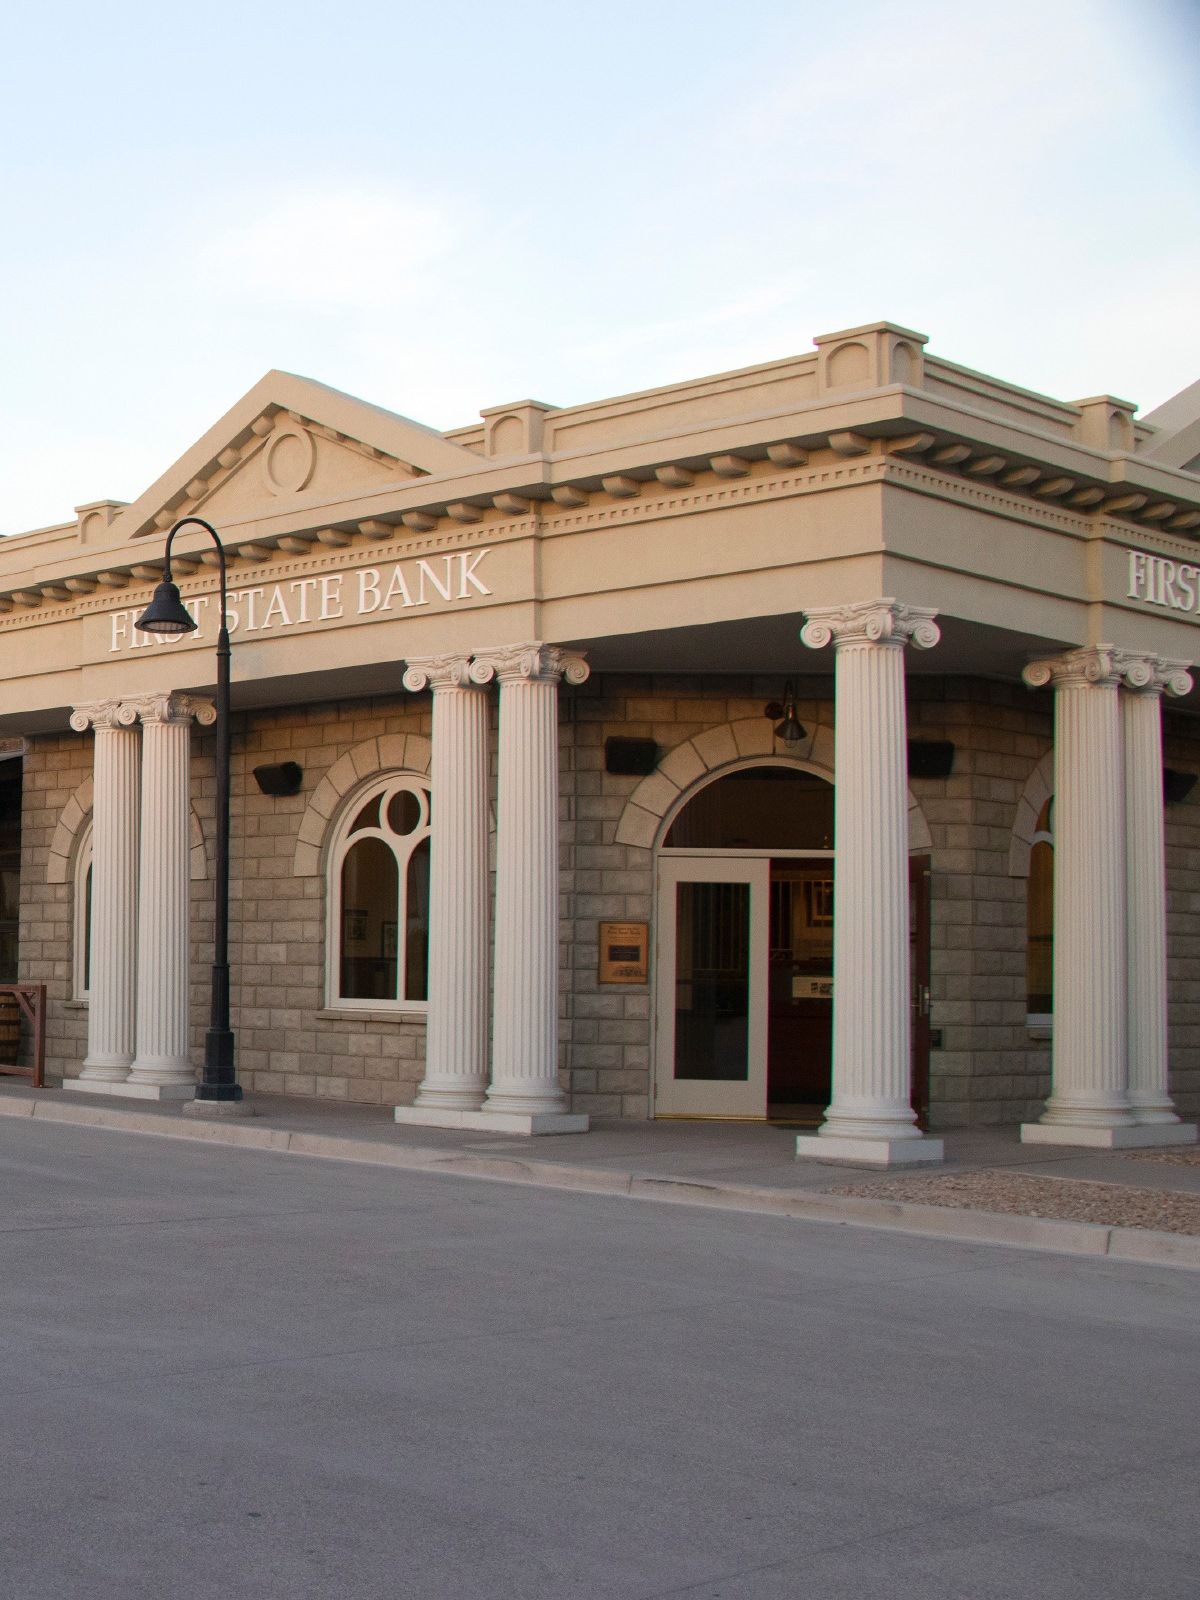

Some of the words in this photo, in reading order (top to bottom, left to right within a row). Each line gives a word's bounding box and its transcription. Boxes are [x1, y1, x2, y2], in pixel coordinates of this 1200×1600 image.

[109, 597, 209, 652] FIT
[218, 574, 344, 634] STATE
[356, 549, 494, 614] BANK
